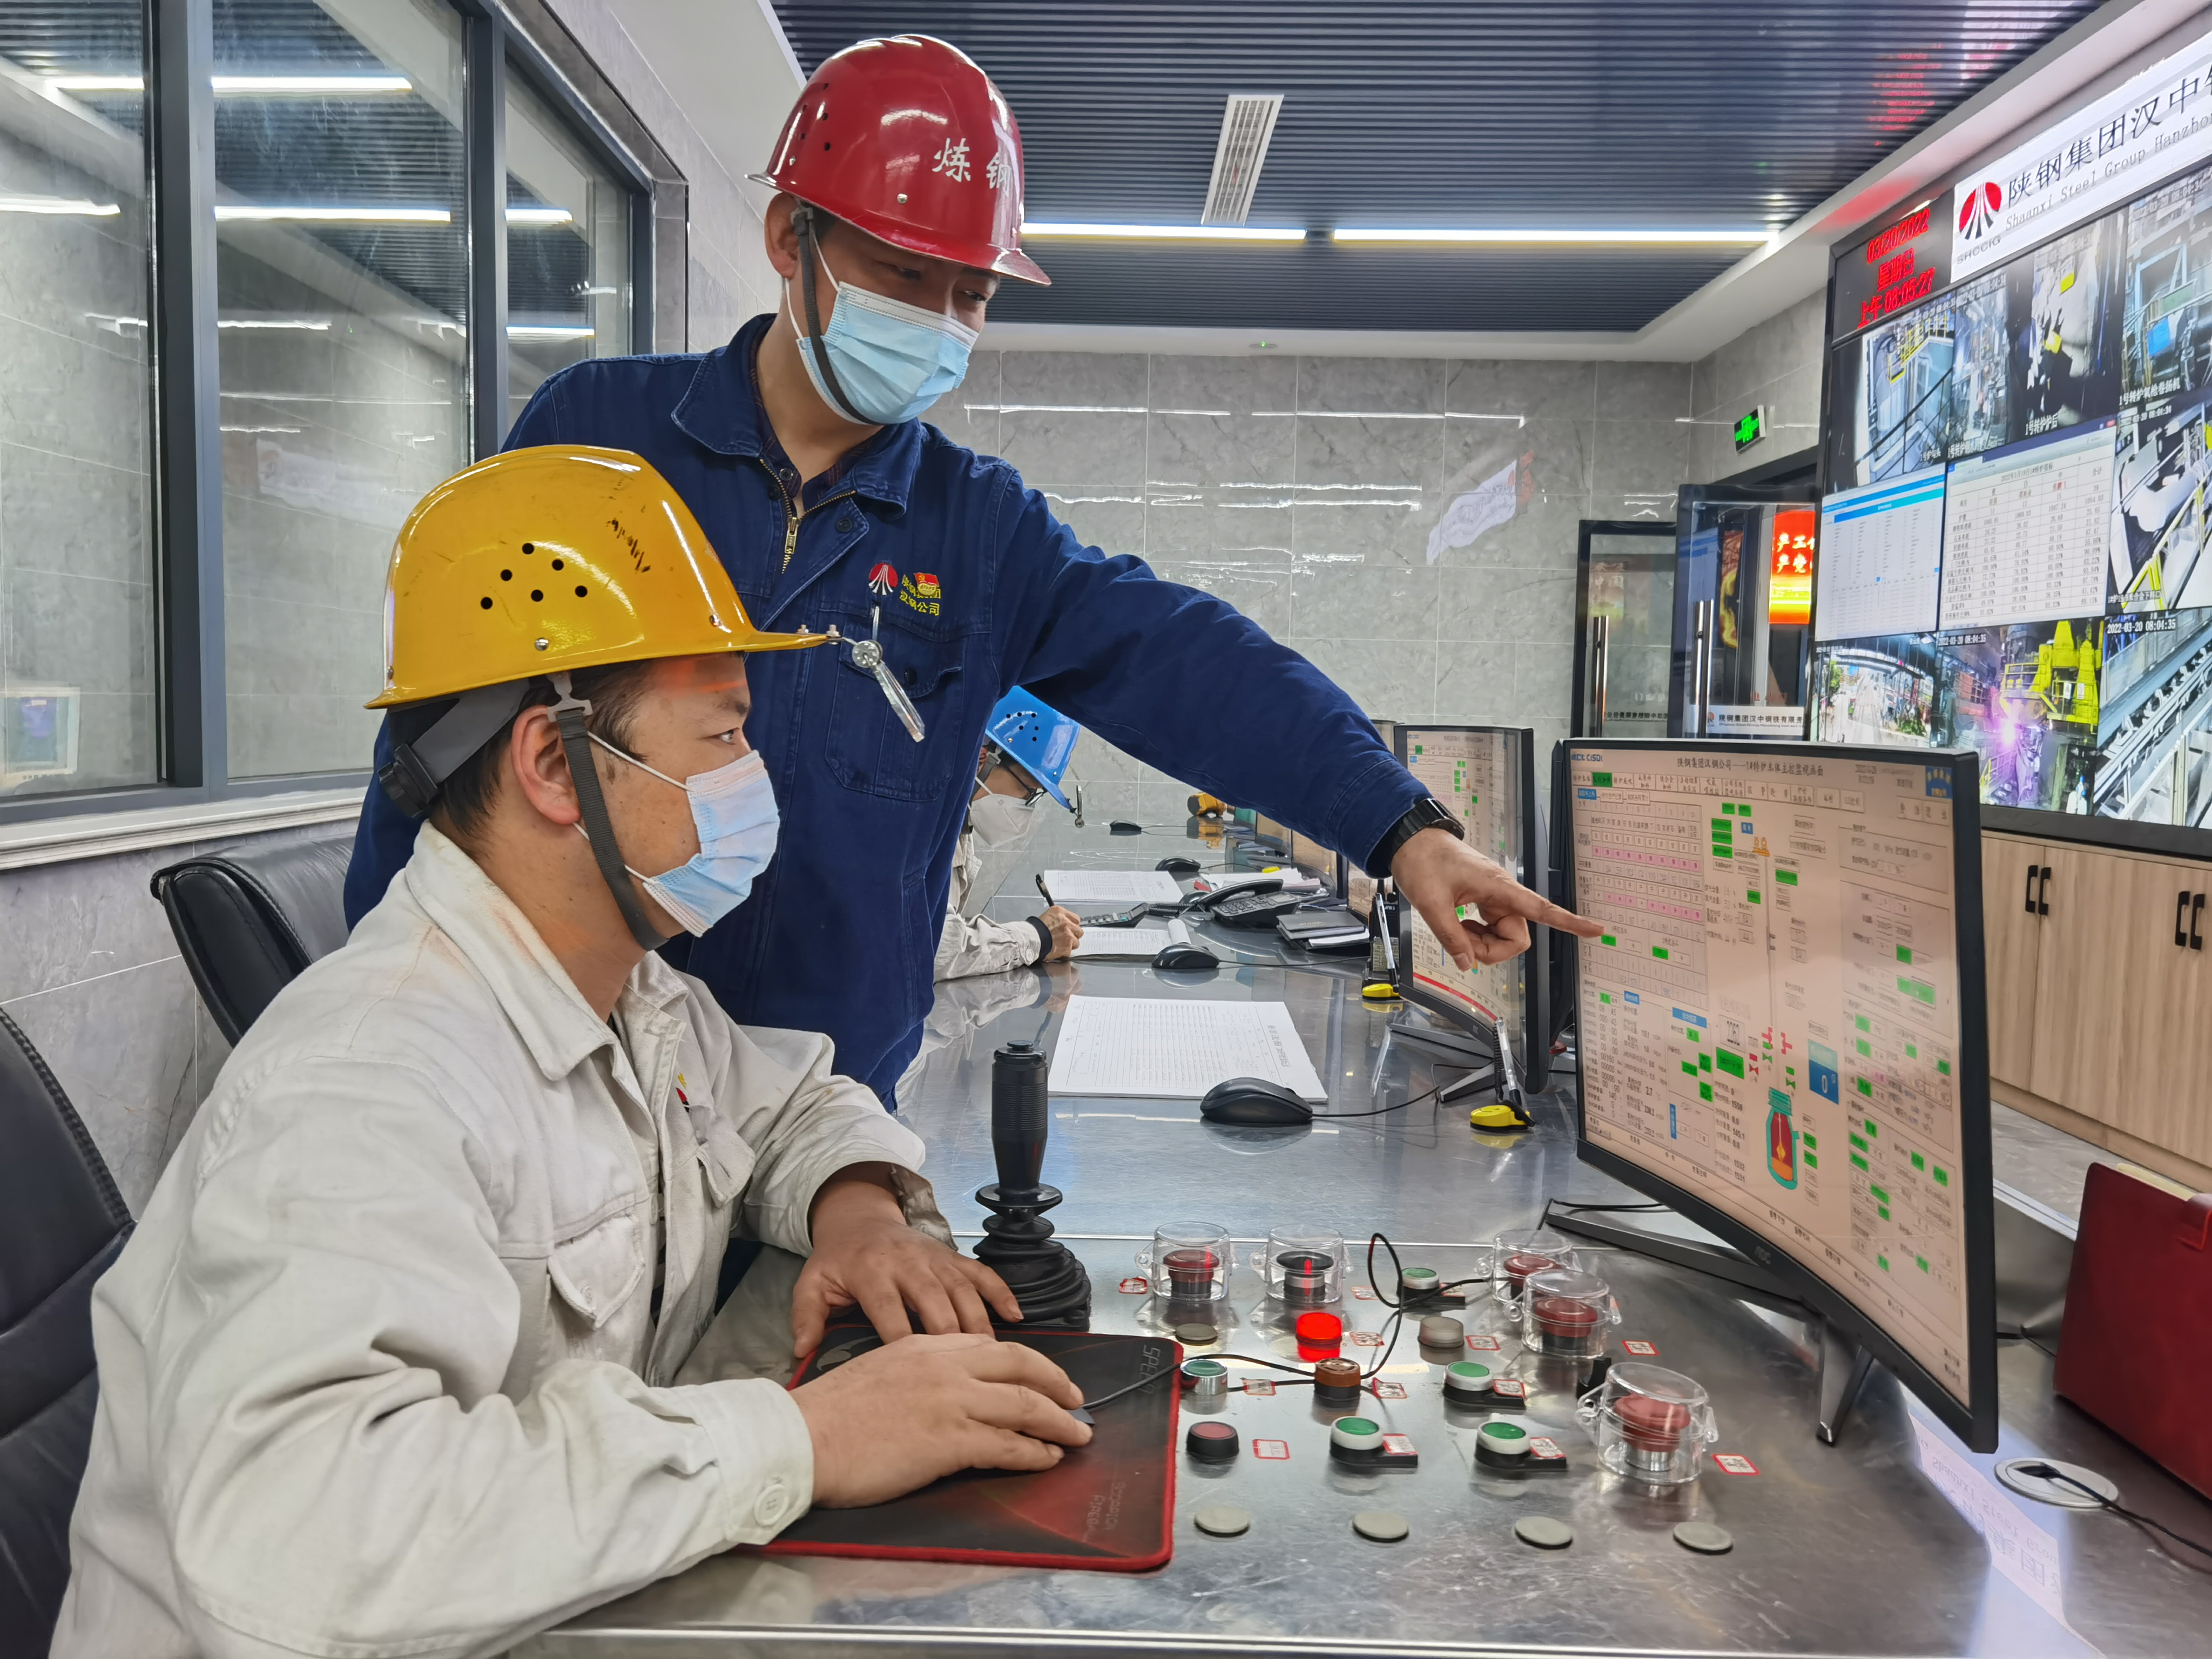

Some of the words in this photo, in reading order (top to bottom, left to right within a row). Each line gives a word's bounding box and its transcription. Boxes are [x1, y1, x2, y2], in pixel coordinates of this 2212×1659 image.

[932, 137, 1011, 197] 炼钢
[2005, 197, 2053, 232] Shaanxi
[2060, 171, 2097, 202] Steel
[2104, 149, 2146, 178] Group
[1867, 207, 1930, 265] 03/20/2022
[1957, 234, 2001, 265] SHCCIG
[1877, 247, 1914, 292] 星期日
[1884, 267, 1936, 314] 08:05:27
[2092, 467, 2102, 476] 合计
[1776, 552, 1813, 574] 严党
[1938, 635, 1963, 646] 2022-03-20
[2107, 621, 2143, 634] 2022-03-20
[2145, 618, 2176, 631] 08:04:35
